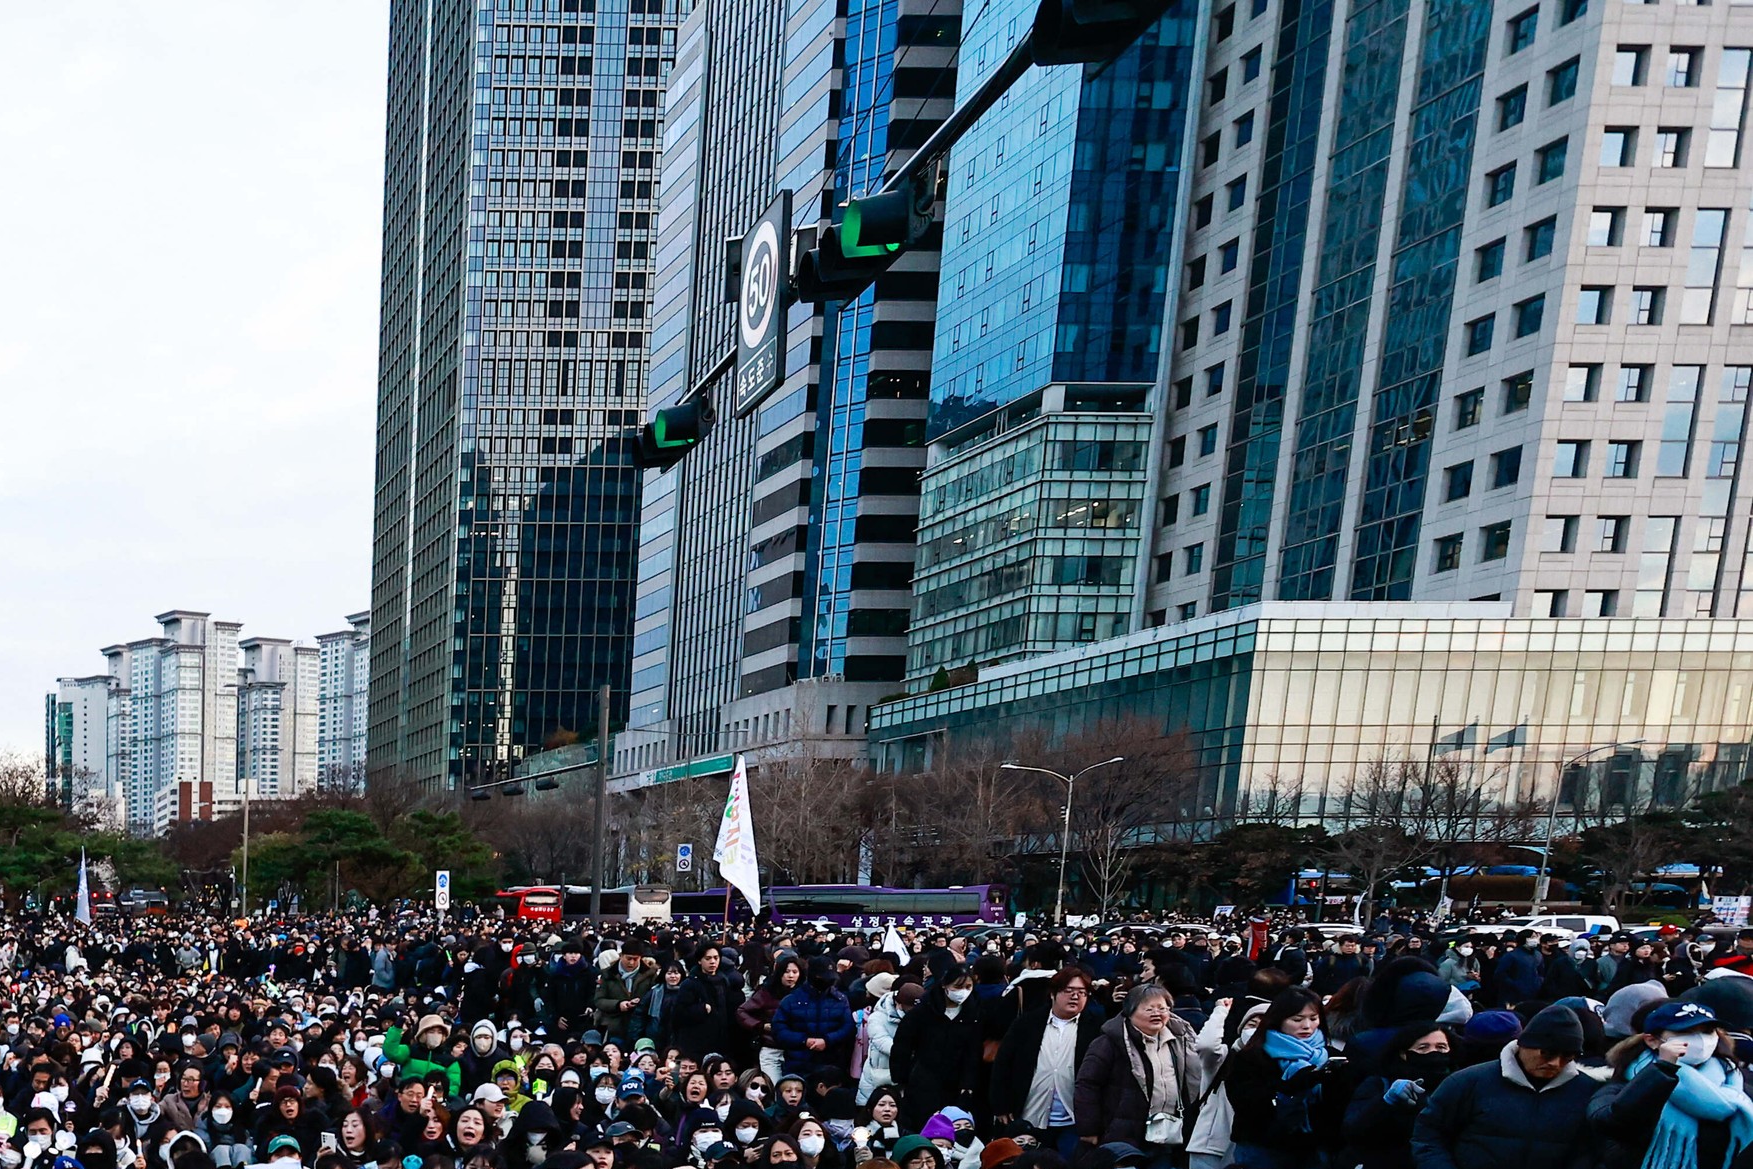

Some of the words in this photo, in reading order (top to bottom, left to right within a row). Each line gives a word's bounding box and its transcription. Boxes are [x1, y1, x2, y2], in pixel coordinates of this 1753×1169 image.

[748, 254, 770, 317] 50
[739, 352, 774, 397] 속도준수
[622, 1082, 639, 1091] POV
